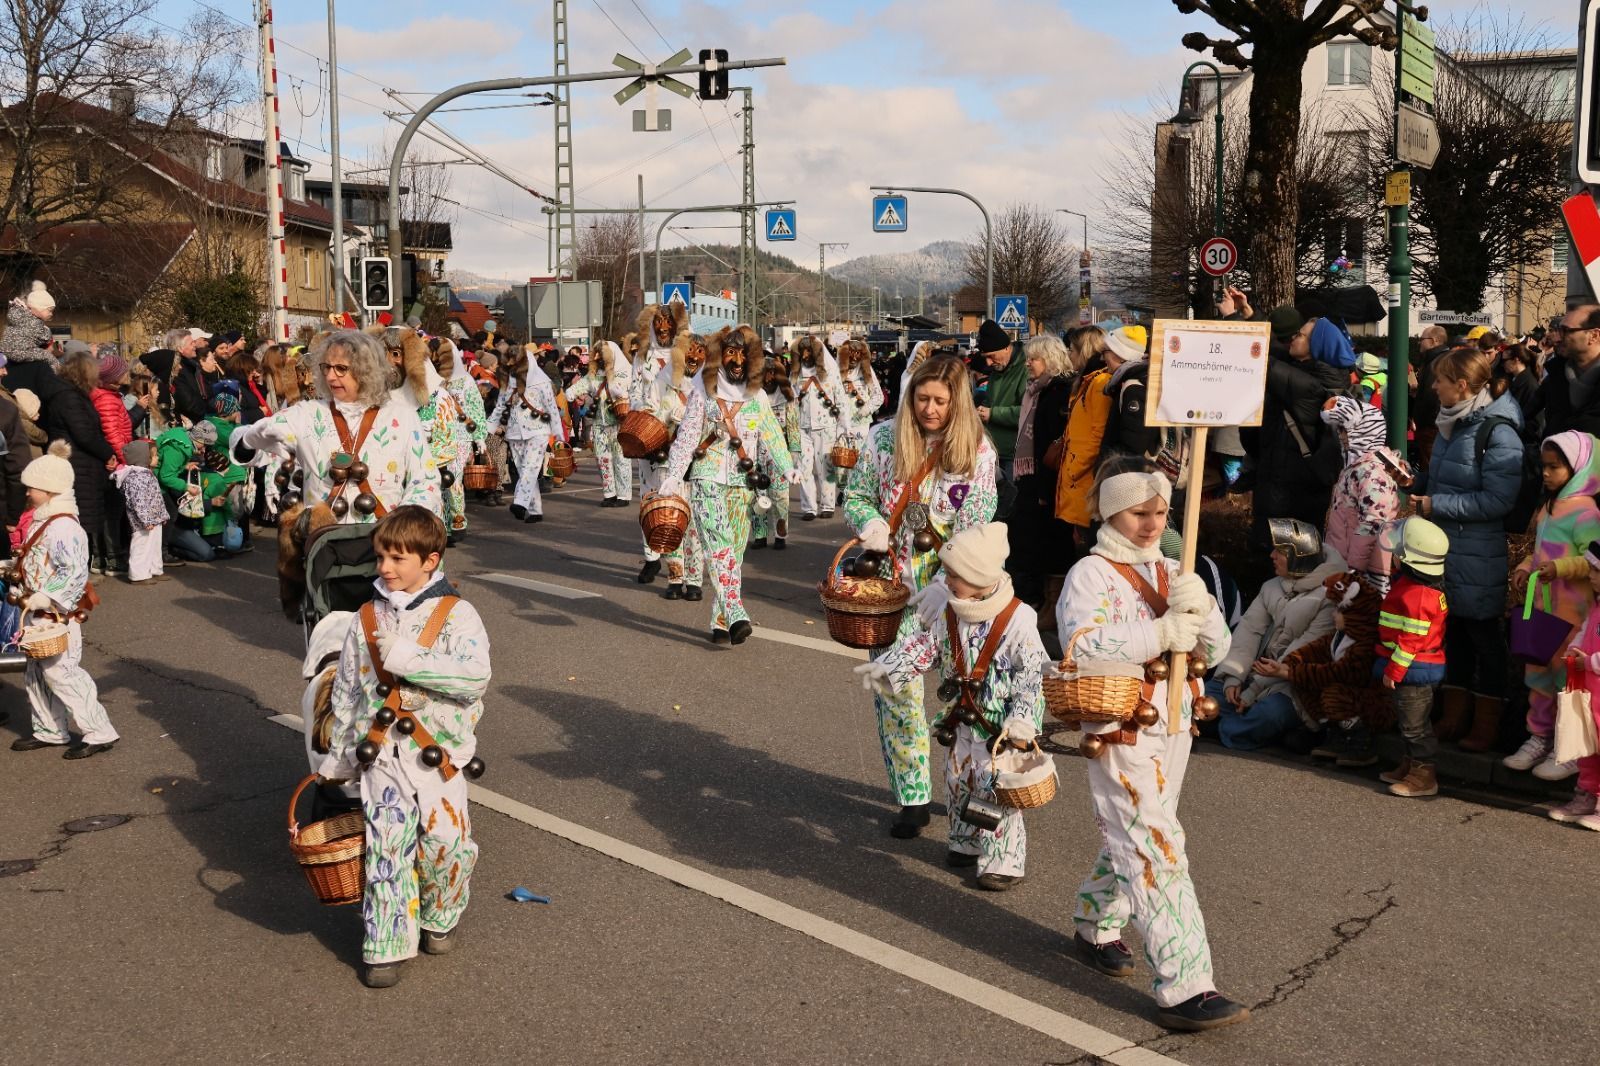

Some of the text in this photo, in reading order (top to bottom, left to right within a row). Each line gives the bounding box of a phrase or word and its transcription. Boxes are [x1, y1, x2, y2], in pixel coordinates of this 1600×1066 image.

[1403, 118, 1428, 151] Bahnhof
[1208, 248, 1229, 265] 30
[1420, 312, 1490, 324] Gartenwirtschaft
[1208, 342, 1223, 354] 18.
[1170, 359, 1233, 372] Ammonshörner
